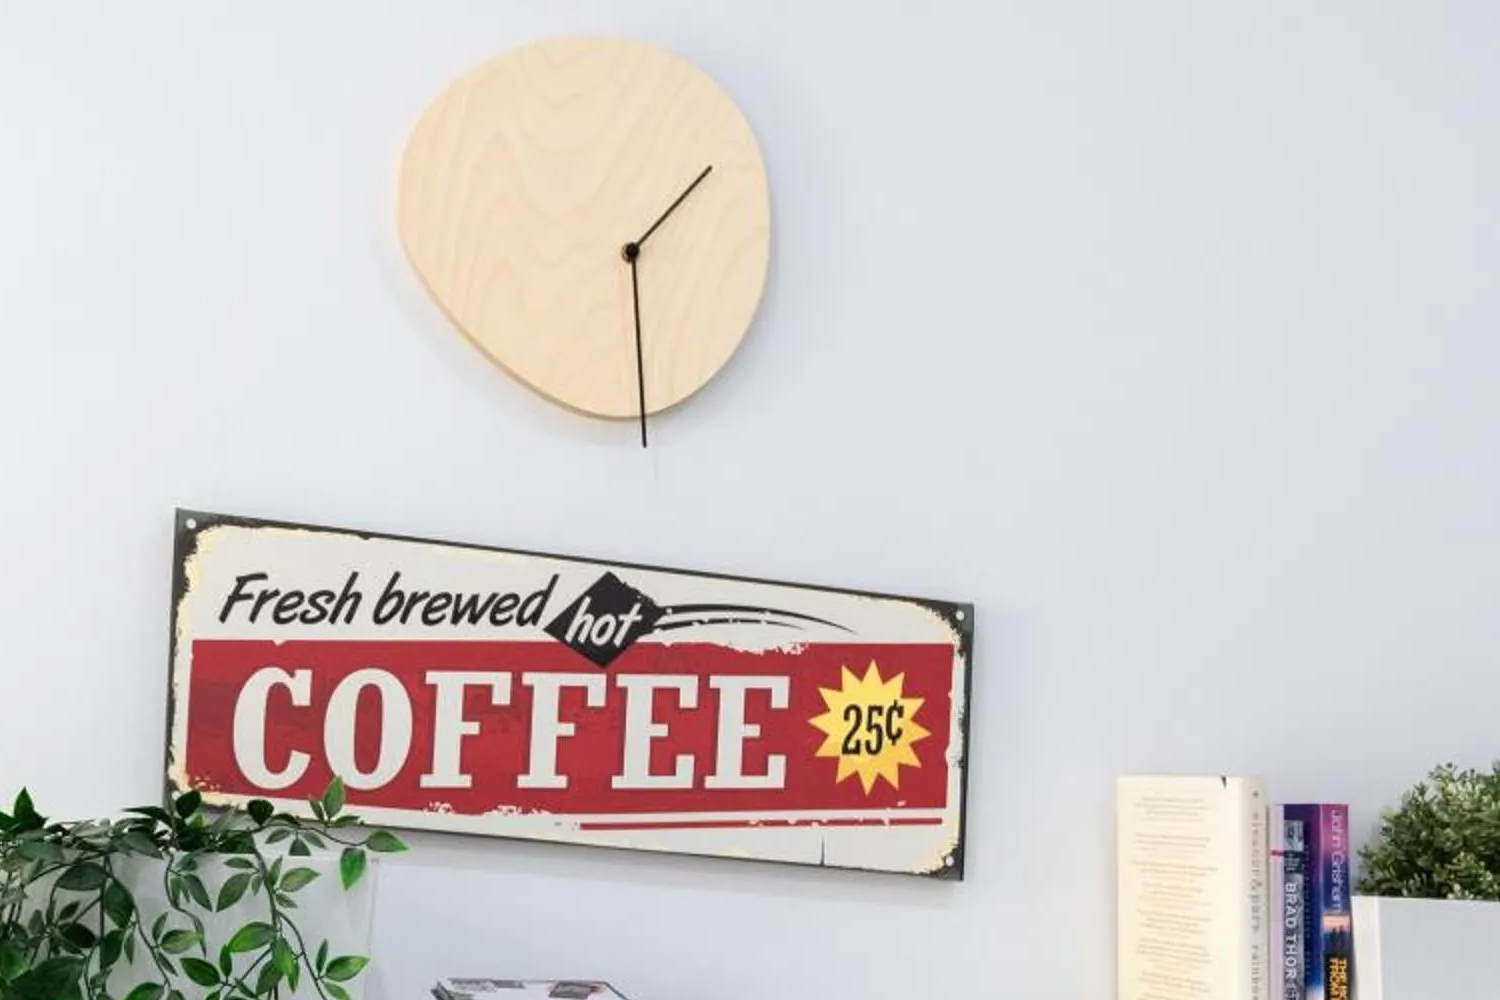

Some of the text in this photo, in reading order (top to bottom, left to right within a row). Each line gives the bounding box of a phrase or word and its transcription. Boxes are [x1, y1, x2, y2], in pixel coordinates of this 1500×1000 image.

[218, 571, 559, 627] Fresh brewed
[566, 596, 641, 648] hot
[232, 666, 791, 791] COFFEE
[841, 699, 905, 757] 25¢
[1331, 809, 1344, 912] John Grisham
[1285, 882, 1297, 979] BRAD THOR
[1338, 958, 1348, 981] THE
